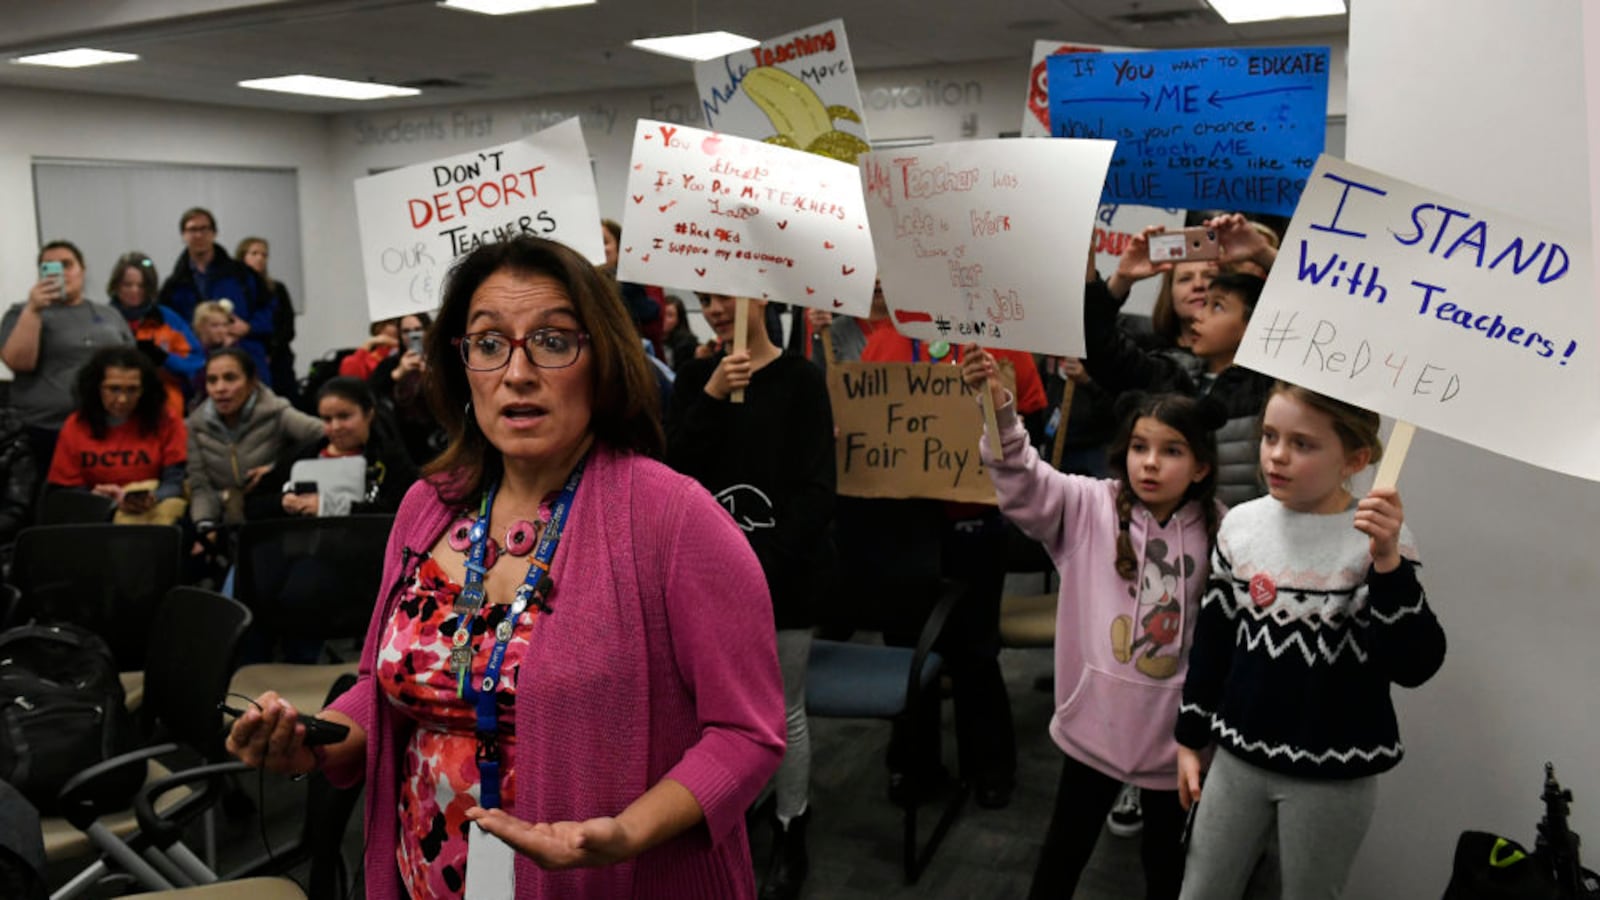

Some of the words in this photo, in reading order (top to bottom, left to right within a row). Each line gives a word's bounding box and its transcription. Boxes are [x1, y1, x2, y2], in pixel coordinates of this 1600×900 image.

[751, 29, 837, 69] Teaching
[801, 59, 849, 85] More
[1112, 58, 1155, 86] YOU
[1171, 57, 1209, 72] WANT
[1218, 55, 1240, 71] TO
[1247, 52, 1327, 77] EDUCATE
[702, 54, 748, 129] Make
[1154, 84, 1202, 114] ME
[1118, 125, 1135, 138] is
[1141, 118, 1185, 143] your
[1210, 139, 1252, 157] ME
[1248, 156, 1284, 170] like
[1292, 157, 1314, 169] to
[433, 150, 505, 188] DON'T
[892, 156, 981, 201] Teacher
[407, 165, 546, 230] DEPORT
[765, 187, 846, 221] TEACHERS
[380, 242, 437, 275] OUR
[438, 210, 557, 259] TEACHERS
[1309, 172, 1388, 239] I
[1393, 202, 1570, 285] STAND
[652, 238, 665, 250] I
[715, 249, 732, 261] my
[1298, 239, 1389, 304] With
[1410, 280, 1578, 367] Teachers!
[843, 368, 888, 399] Will
[906, 367, 973, 397] Work
[886, 403, 940, 435] For
[80, 449, 152, 468] DCTA
[844, 432, 907, 474] Fair
